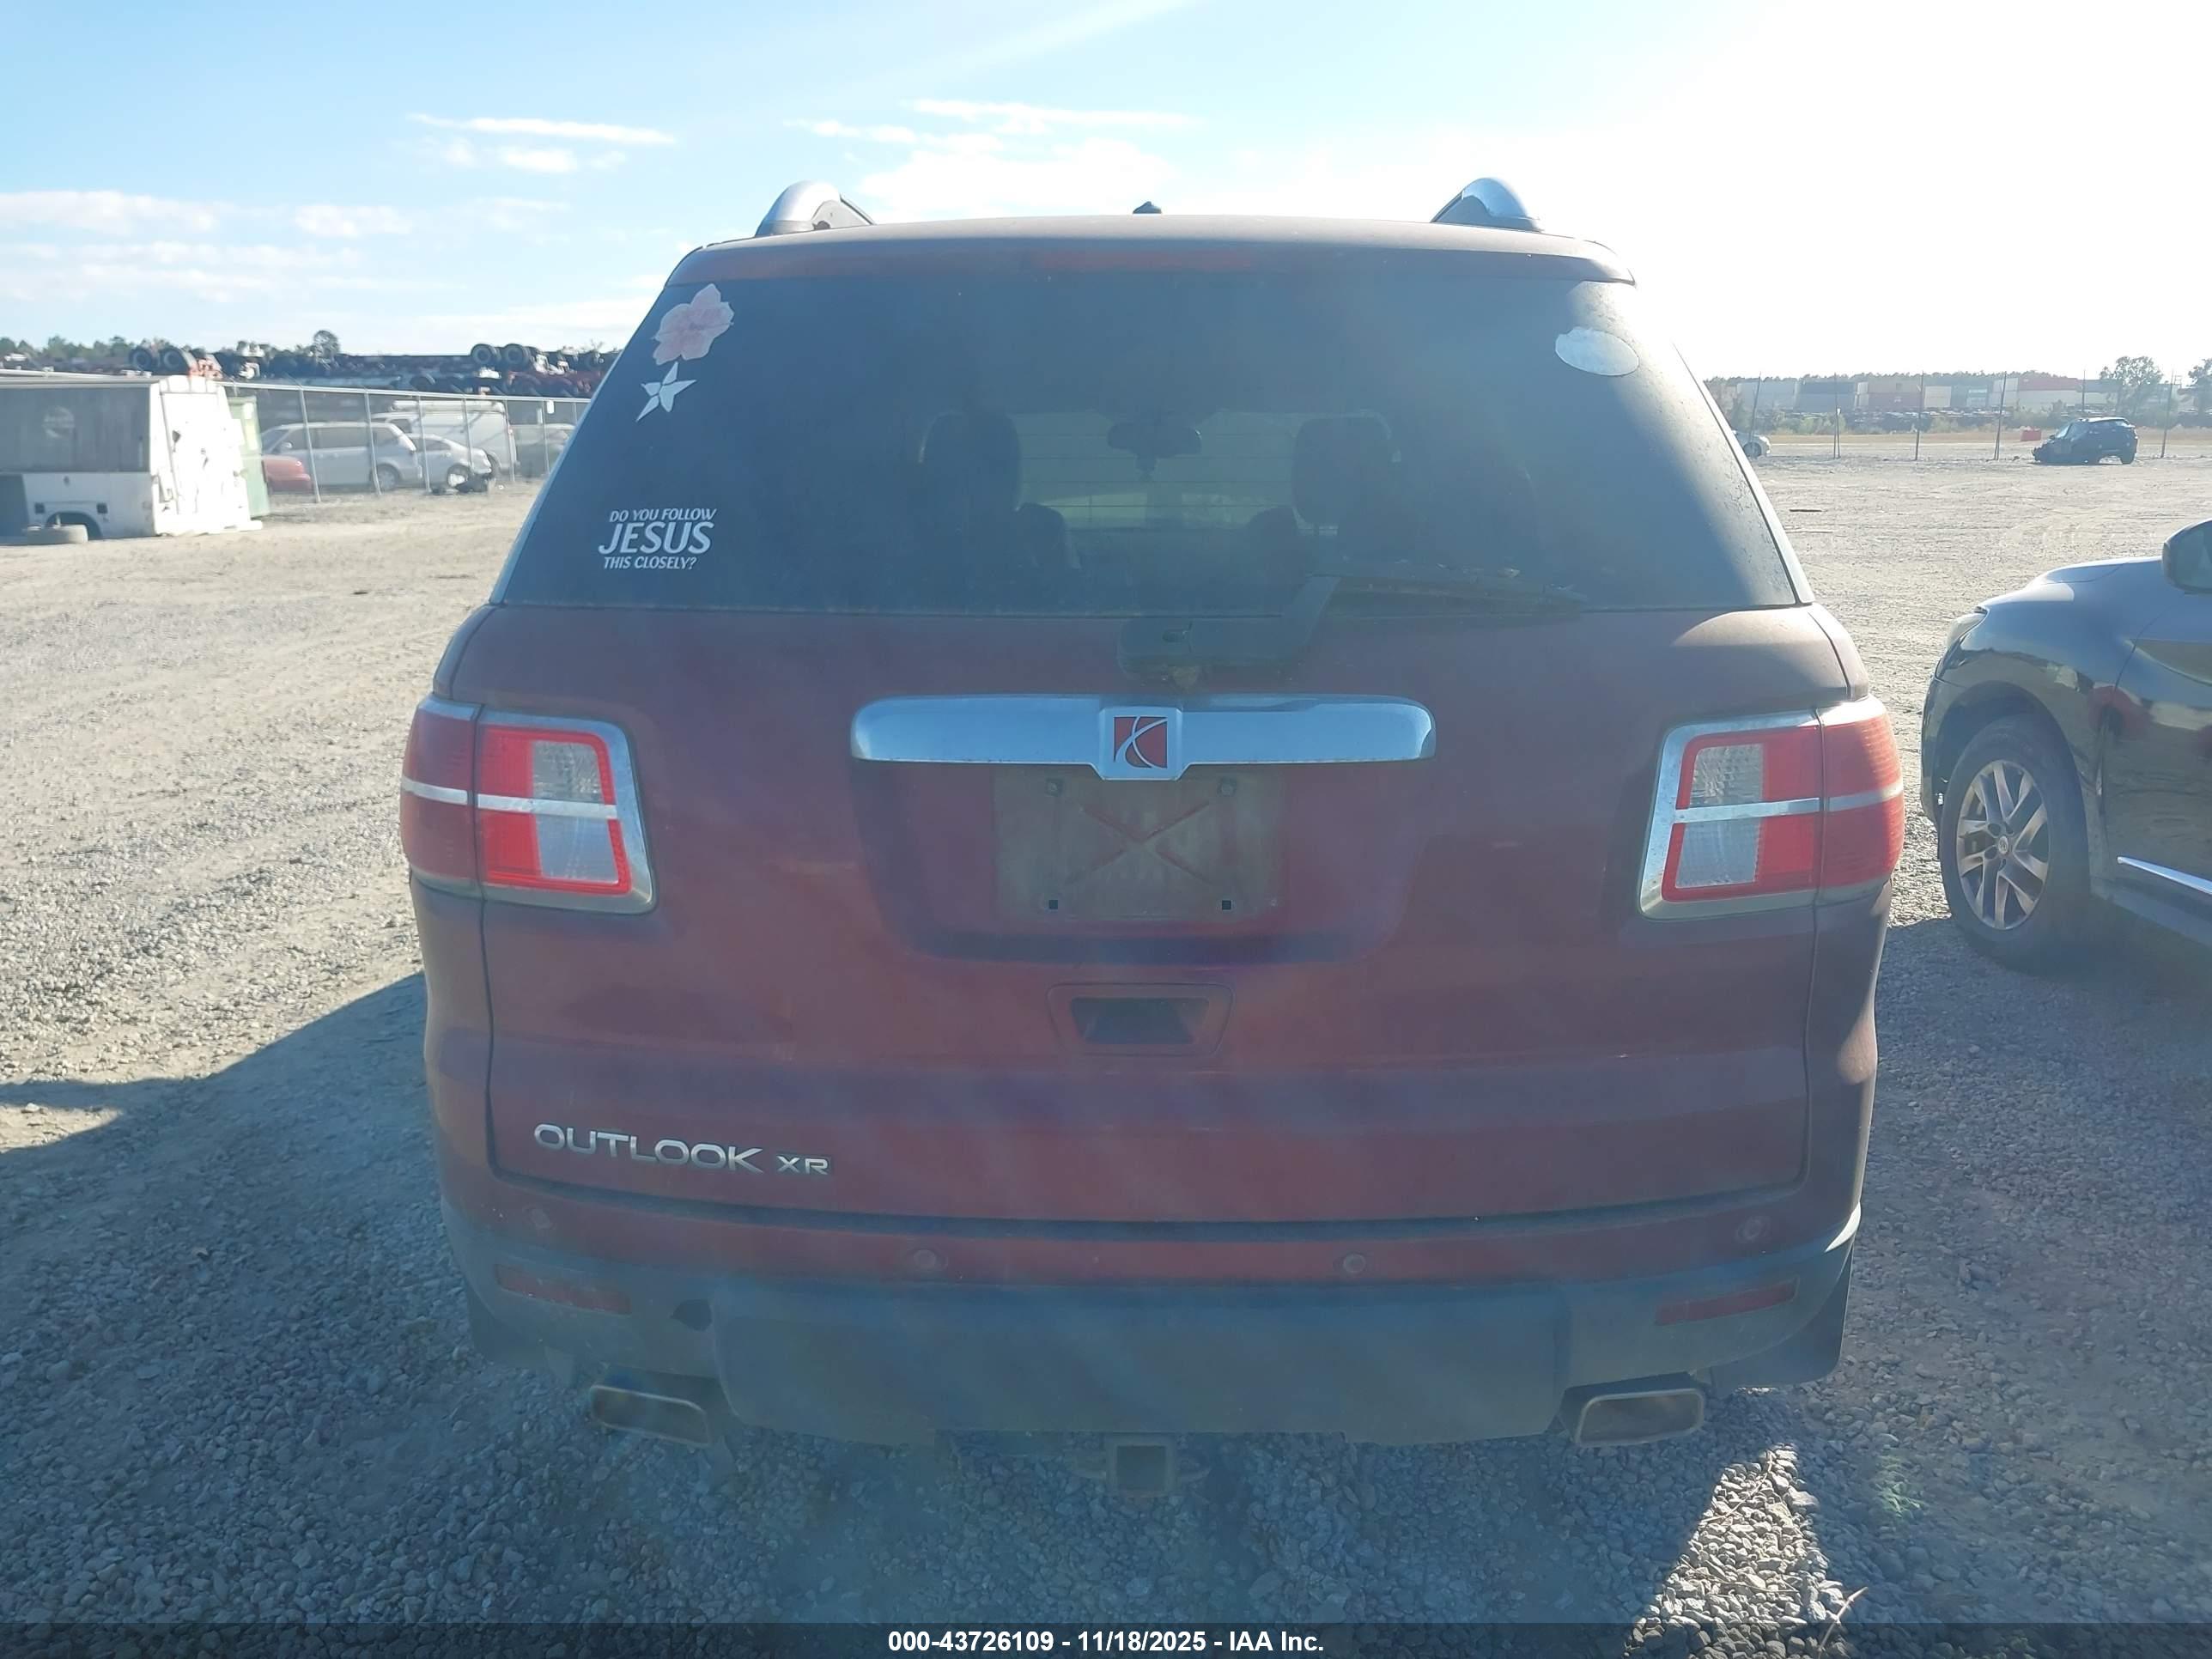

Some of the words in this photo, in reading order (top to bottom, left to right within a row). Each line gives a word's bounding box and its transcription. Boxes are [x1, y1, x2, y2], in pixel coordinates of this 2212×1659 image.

[609, 509, 629, 522] DO
[633, 508, 659, 521] YOU
[661, 507, 717, 520] FOLLOW
[598, 520, 714, 555] JESUS
[604, 556, 632, 569] THIS
[634, 556, 697, 570] CLOSELY?
[533, 1123, 763, 1174] OUTLOOK
[776, 1154, 830, 1175] XR
